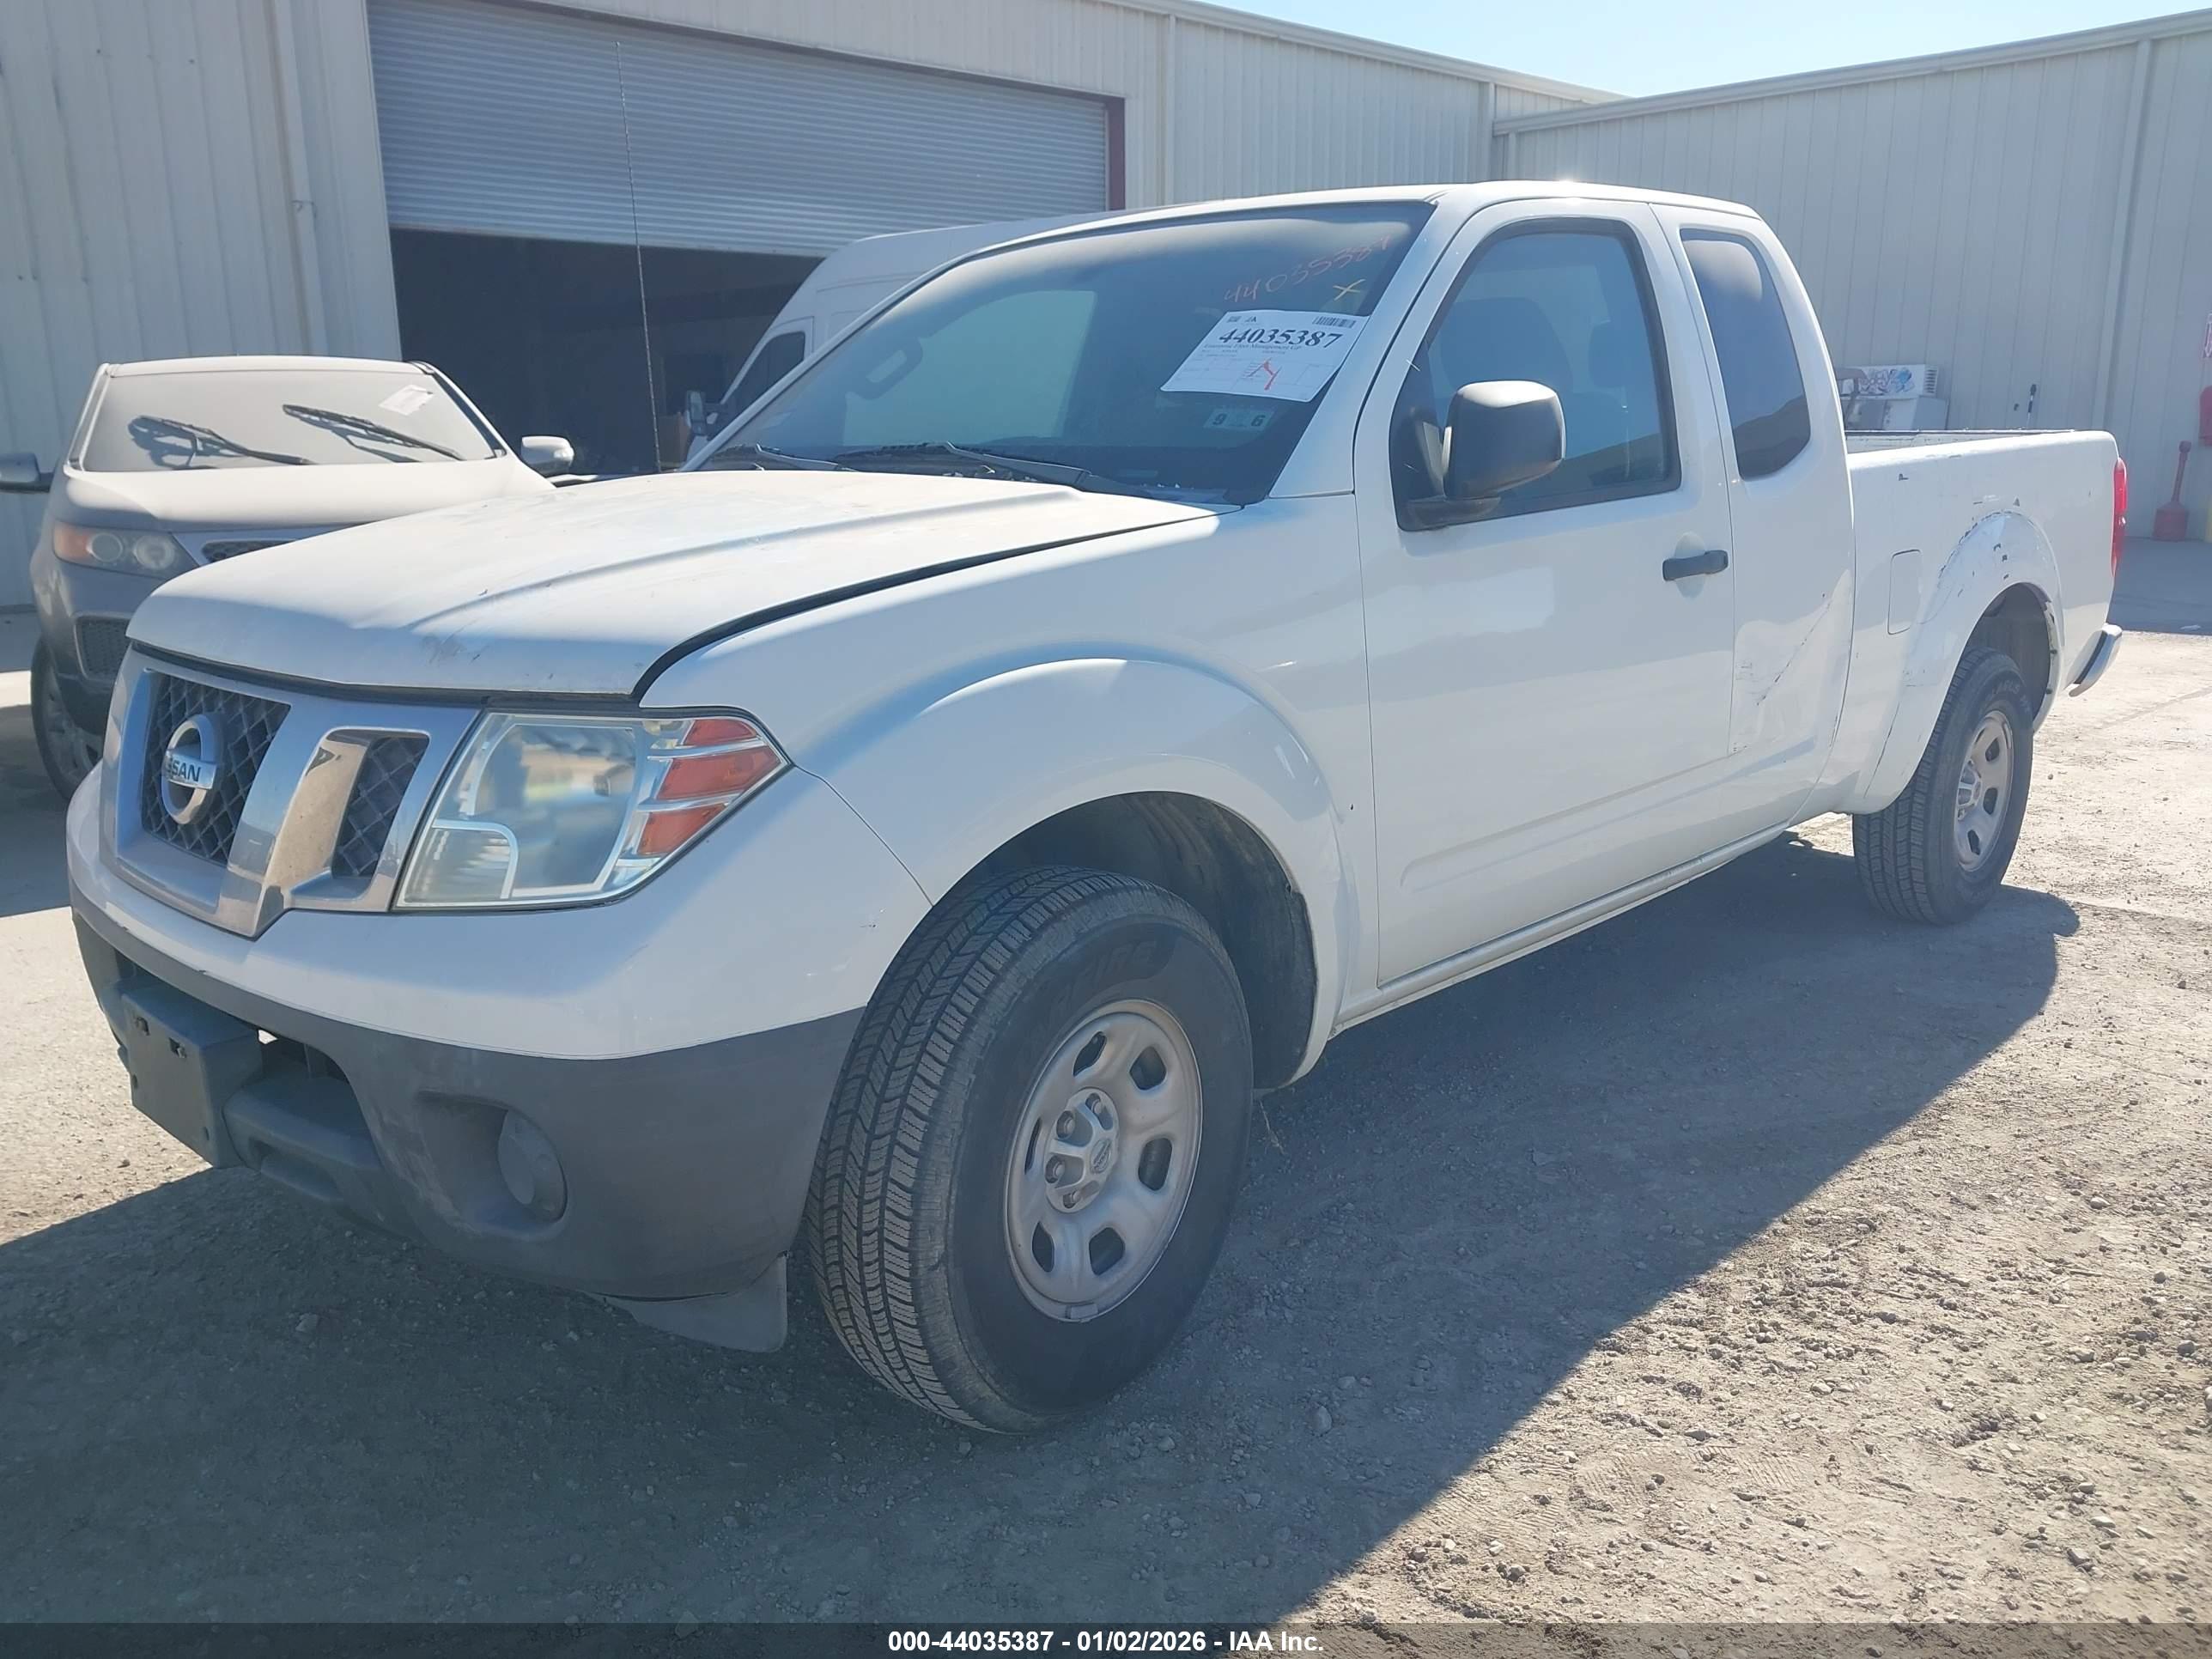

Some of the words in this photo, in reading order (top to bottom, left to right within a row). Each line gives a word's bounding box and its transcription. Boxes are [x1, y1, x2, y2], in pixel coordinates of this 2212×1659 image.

[1218, 328, 1343, 348] 44035387
[1212, 413, 1228, 426] 9
[1250, 415, 1266, 427] 6
